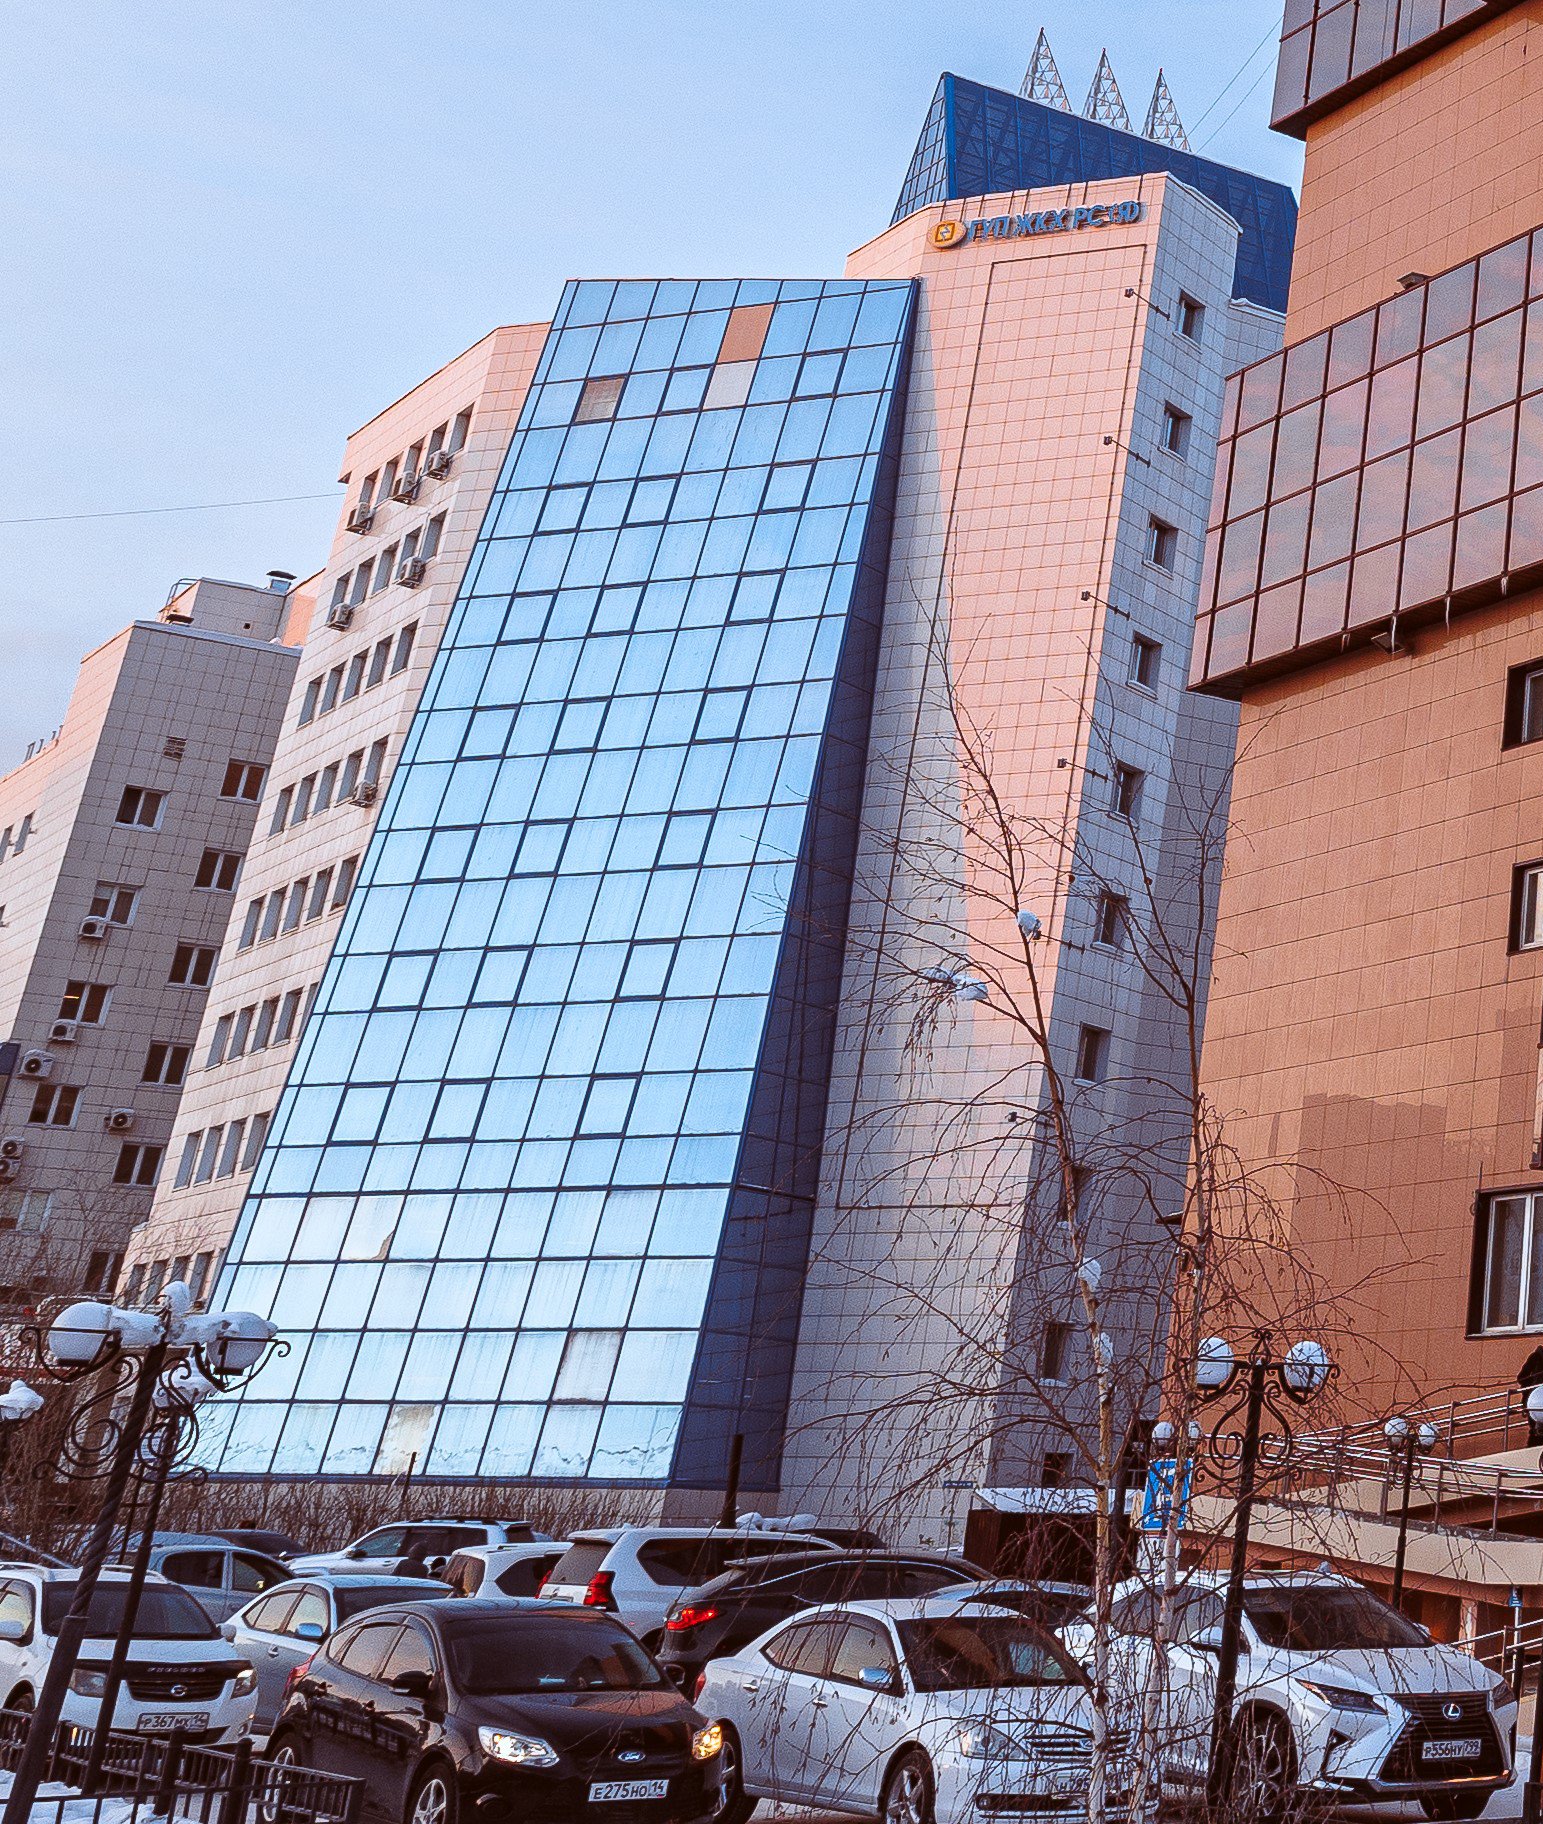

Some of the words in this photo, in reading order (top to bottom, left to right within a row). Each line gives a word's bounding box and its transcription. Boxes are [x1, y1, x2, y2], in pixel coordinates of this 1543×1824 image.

[967, 215, 1010, 240] ГУП
[1014, 208, 1068, 234] ЖКХ
[1073, 205, 1105, 228] РС
